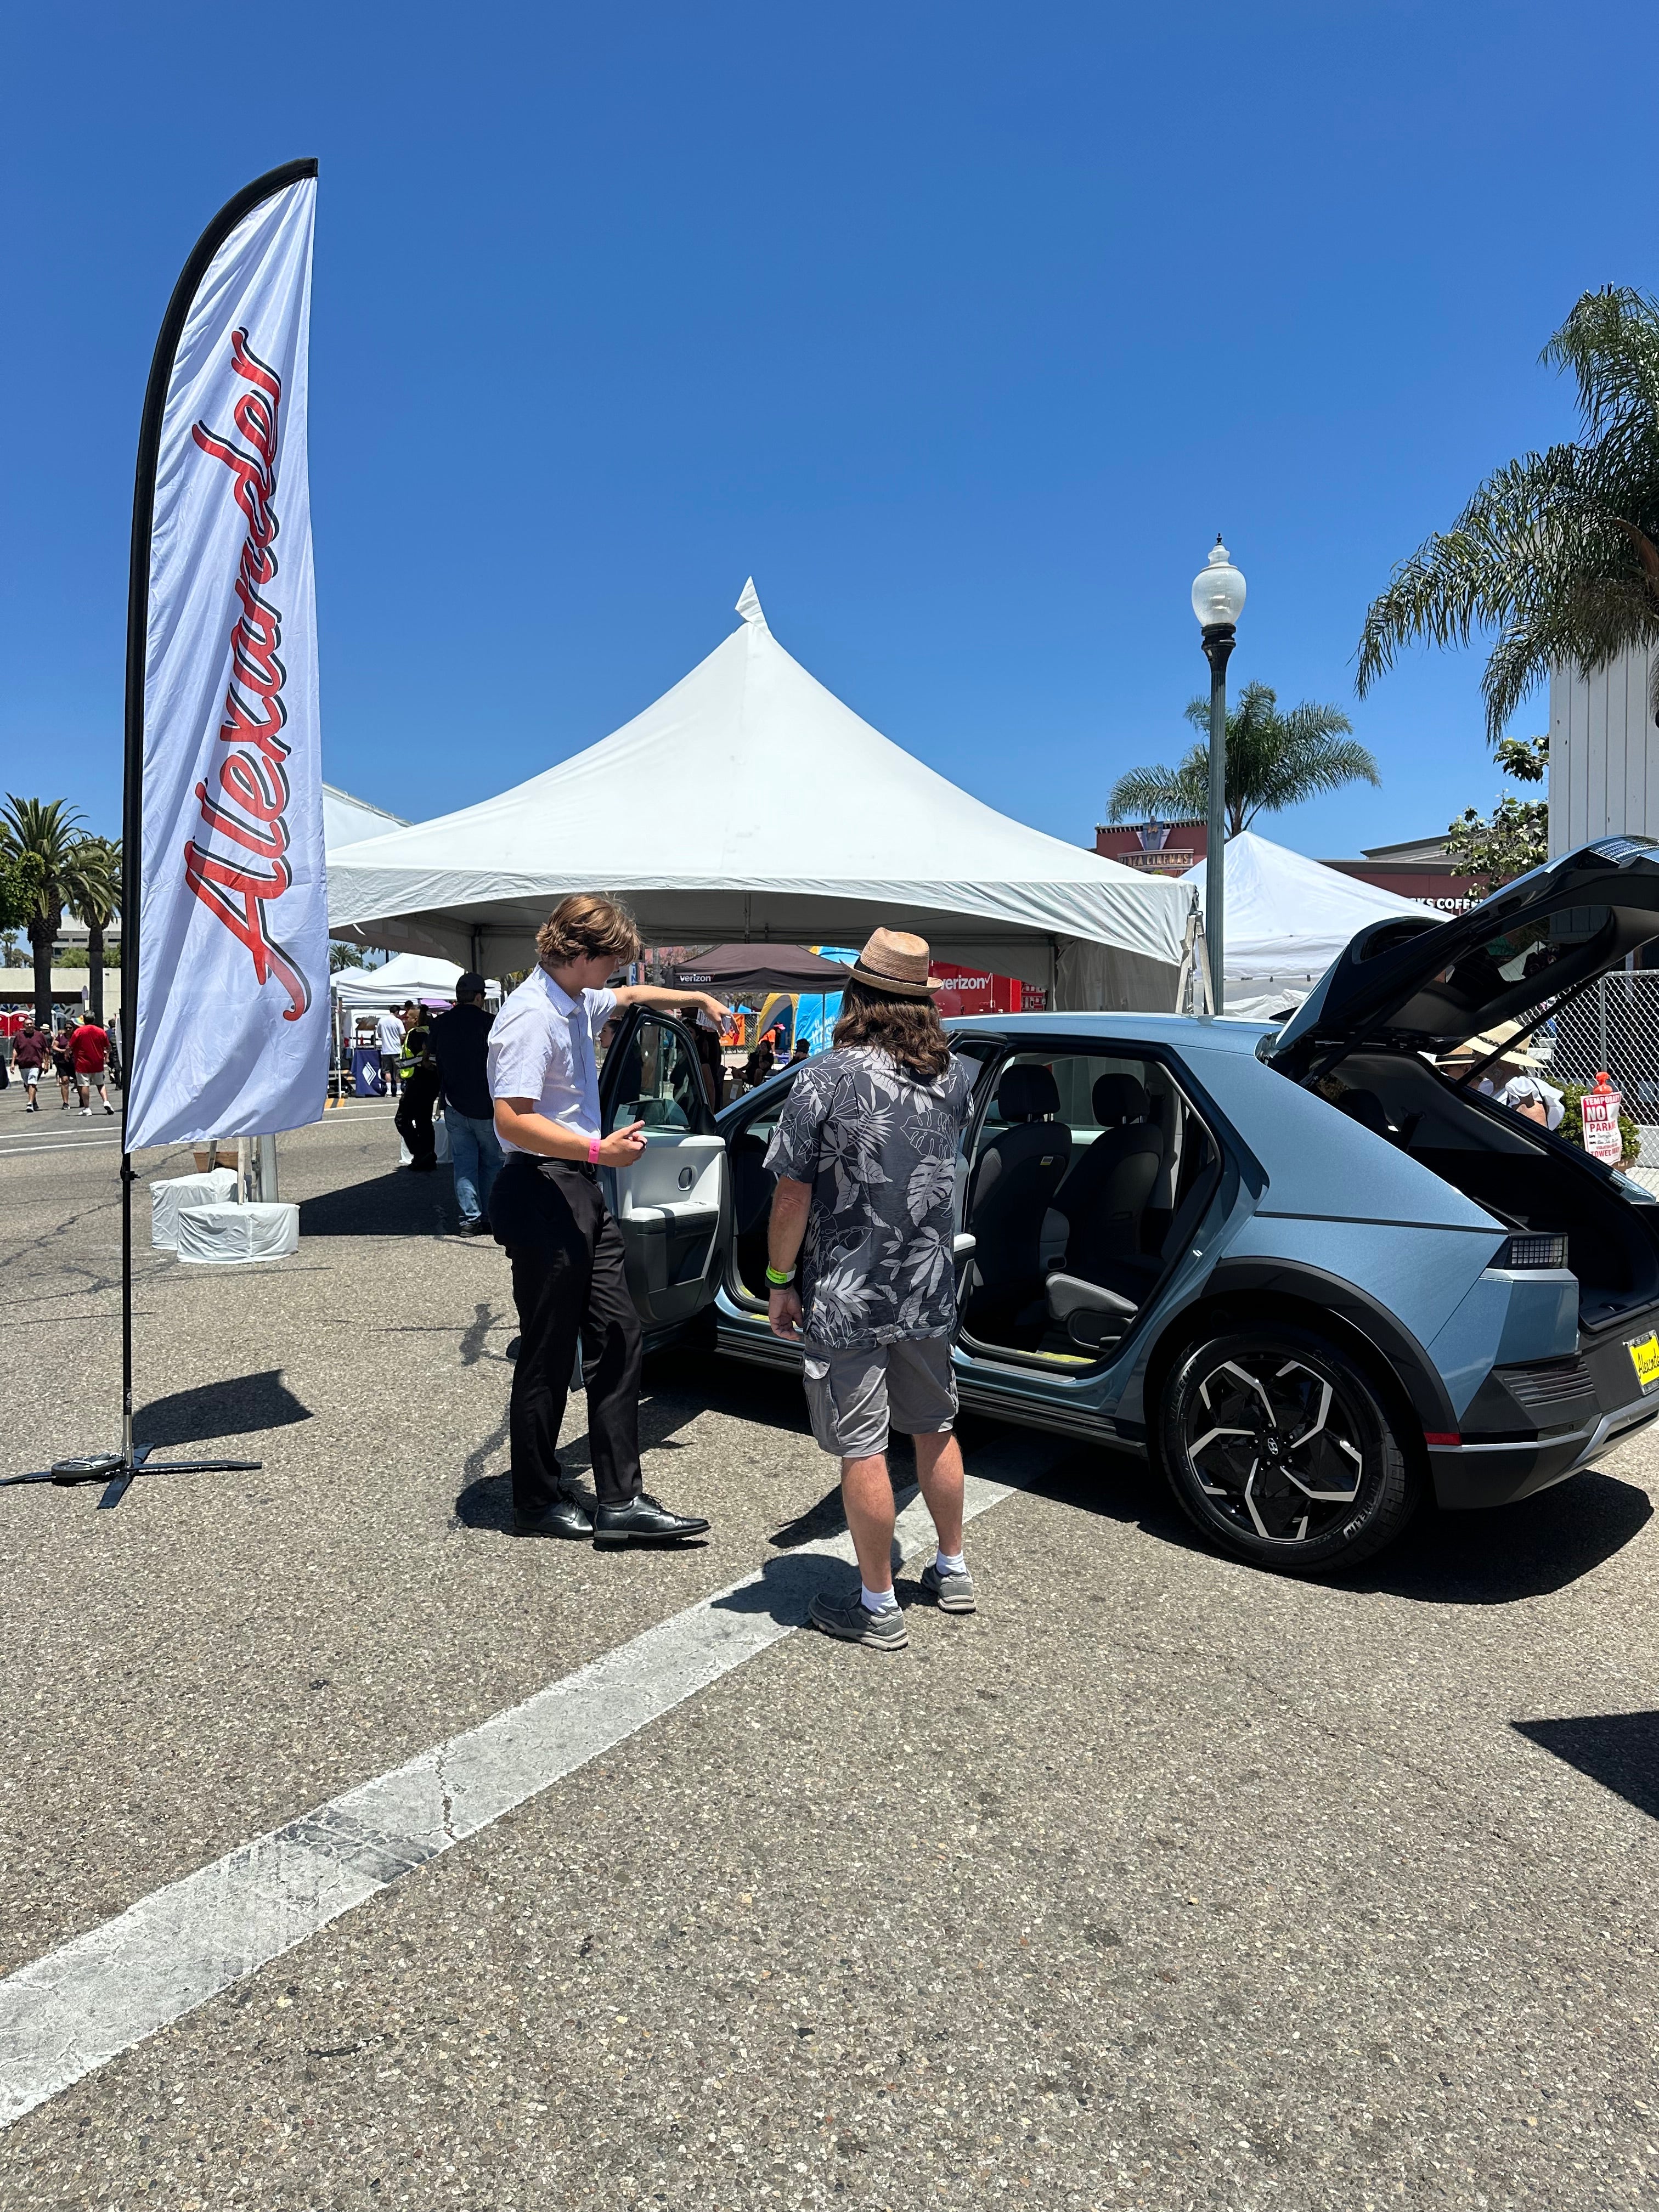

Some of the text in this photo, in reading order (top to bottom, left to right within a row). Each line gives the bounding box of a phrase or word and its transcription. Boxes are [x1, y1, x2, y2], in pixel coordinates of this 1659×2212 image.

[185, 326, 312, 1020] Alexander
[1146, 854, 1189, 865] CINEMAS
[680, 973, 712, 982] verizon
[940, 974, 985, 990] verizon
[1586, 1105, 1606, 1121] NO
